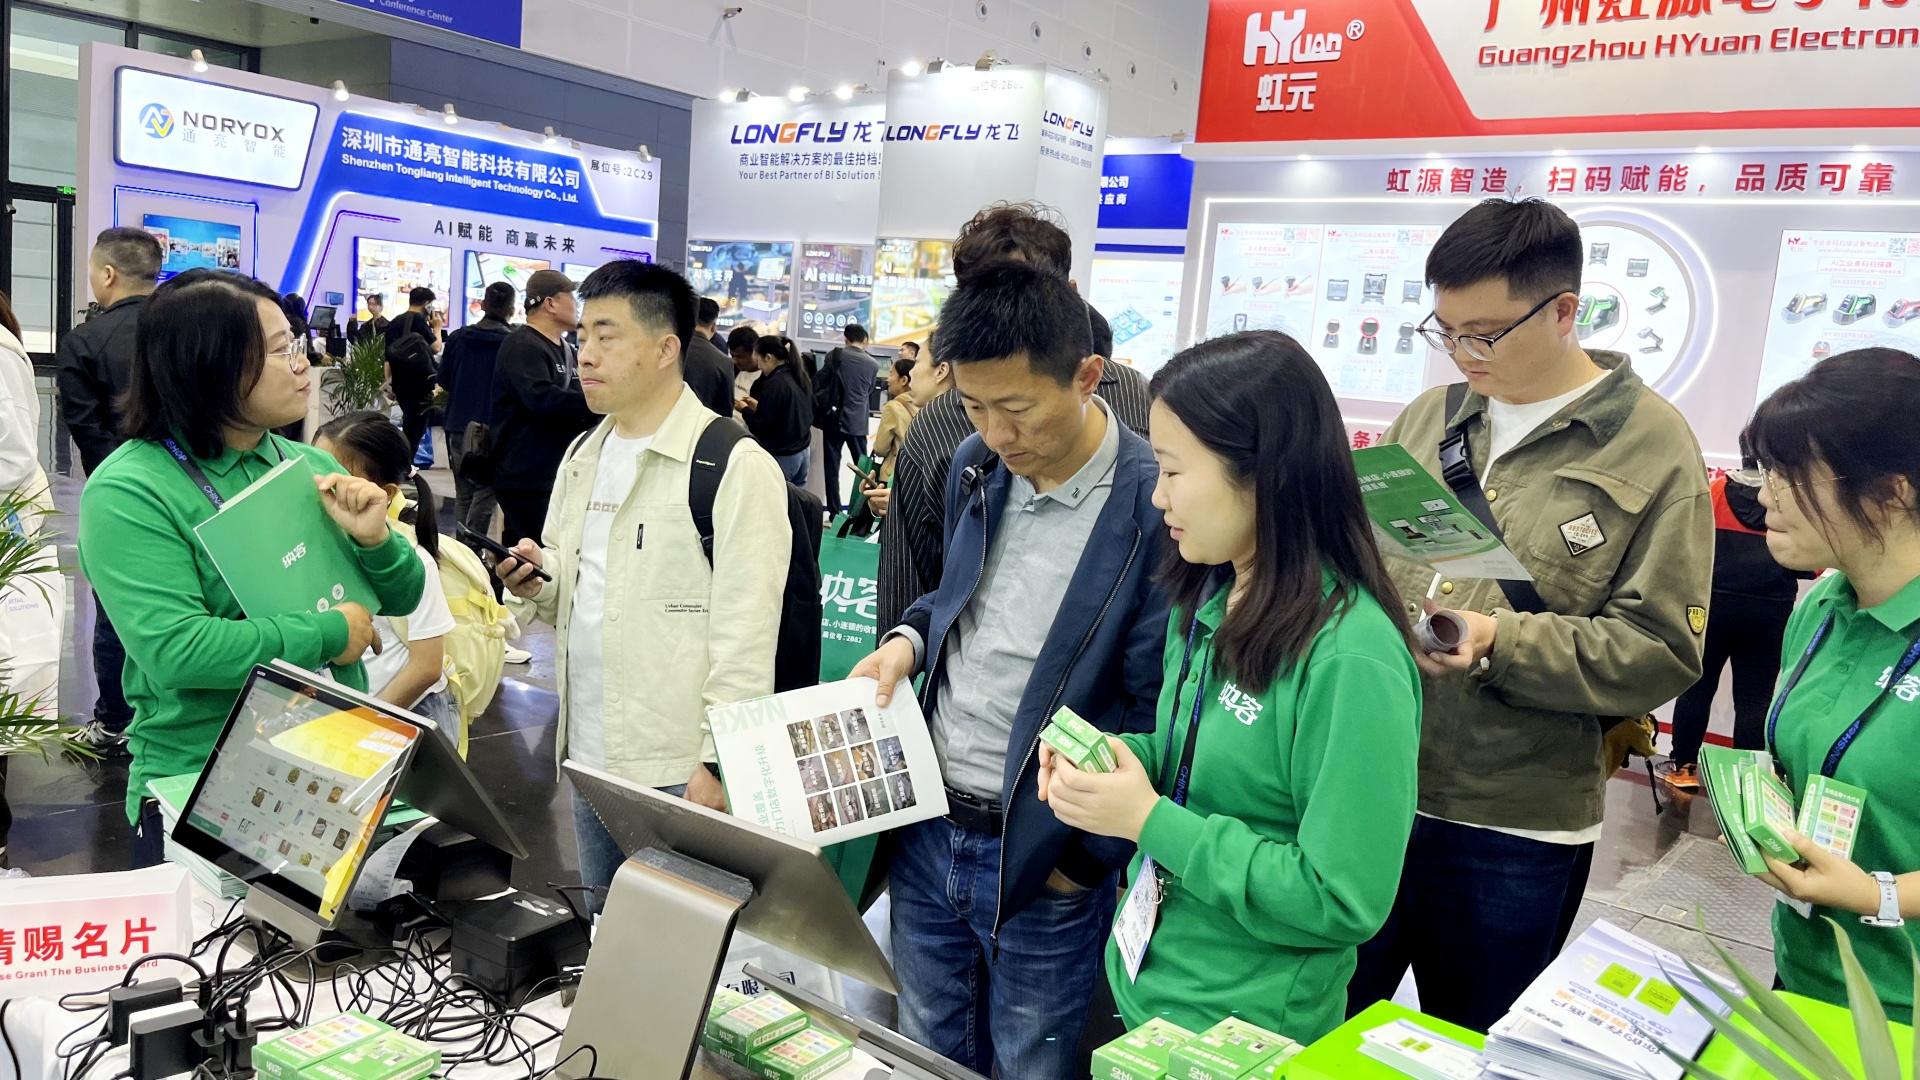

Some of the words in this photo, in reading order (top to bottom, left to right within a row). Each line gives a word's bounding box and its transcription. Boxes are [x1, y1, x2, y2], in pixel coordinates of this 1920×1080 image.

[427, 9, 453, 23] Center
[1477, 37, 1646, 68] Guangzhou
[1654, 32, 1761, 59] HYuan
[1255, 71, 1318, 112] 虹元
[183, 110, 286, 143] NORYOX
[730, 121, 850, 145] LONGFLY
[886, 123, 982, 142] LONGFLY
[985, 123, 1019, 141] 龙飞
[1043, 110, 1094, 137] LONGFLY
[182, 128, 286, 158] 通亮智能
[342, 126, 580, 189] 深圳市通亮智能科技有限公司
[342, 153, 394, 172] Shenzhen
[396, 163, 444, 183] Tongliang
[445, 171, 491, 189] Intelligent
[493, 180, 544, 199] Technology
[739, 170, 758, 180] Your
[759, 170, 777, 180] Best
[779, 170, 812, 180] Partner
[814, 170, 824, 180] of
[836, 170, 875, 180] Solution
[1734, 162, 1895, 194] 品质可靠
[433, 219, 493, 243] AI赋能
[505, 228, 577, 254] 商赢未来
[15, 970, 48, 979] Grant
[51, 966, 71, 976] The
[75, 962, 128, 975] Business
